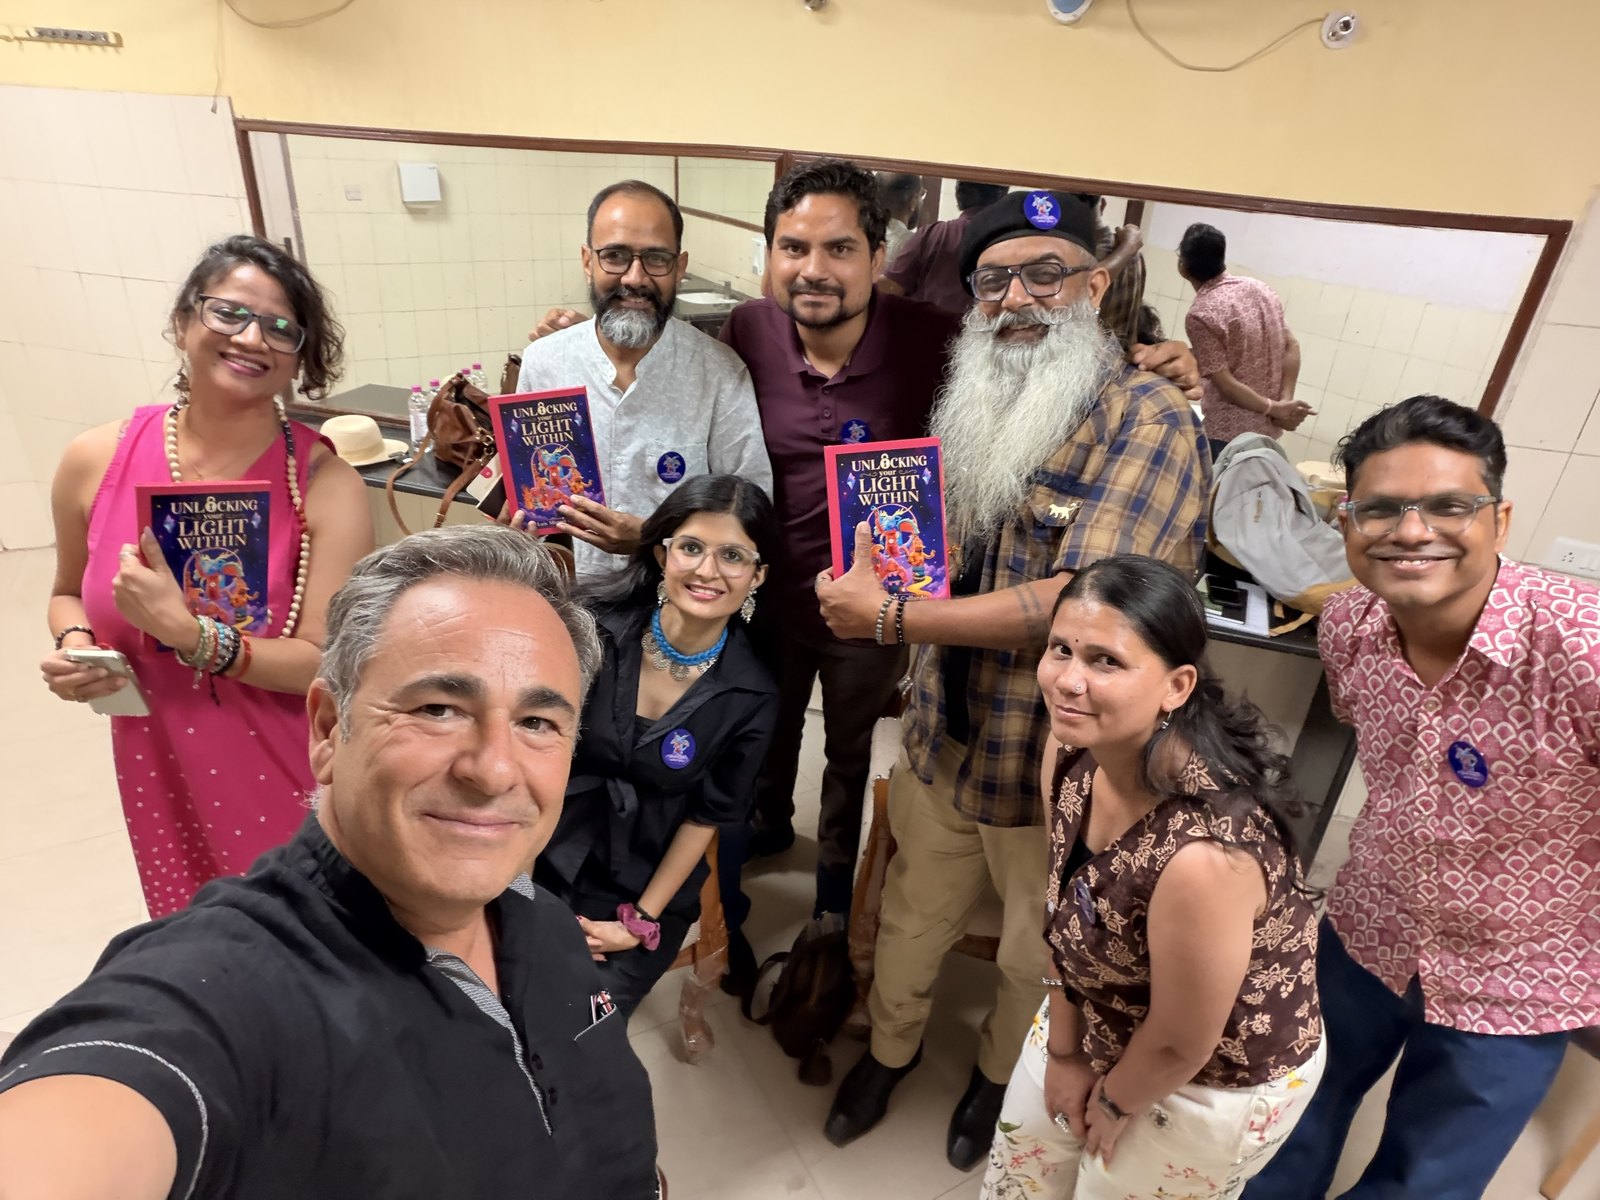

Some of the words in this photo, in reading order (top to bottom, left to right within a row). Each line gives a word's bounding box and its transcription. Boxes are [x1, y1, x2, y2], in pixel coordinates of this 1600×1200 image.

[513, 402, 577, 418] UNLOCKING
[521, 419, 573, 436] LIGHT
[522, 432, 574, 446] WITHIN
[851, 453, 928, 472] UNLOCKING
[859, 475, 919, 493] LIGHT
[170, 496, 258, 514] UNLOCKING
[858, 491, 919, 506] WITHIN
[203, 513, 223, 521] your
[179, 519, 248, 537] LIGHT
[177, 534, 247, 550] WITHIN
